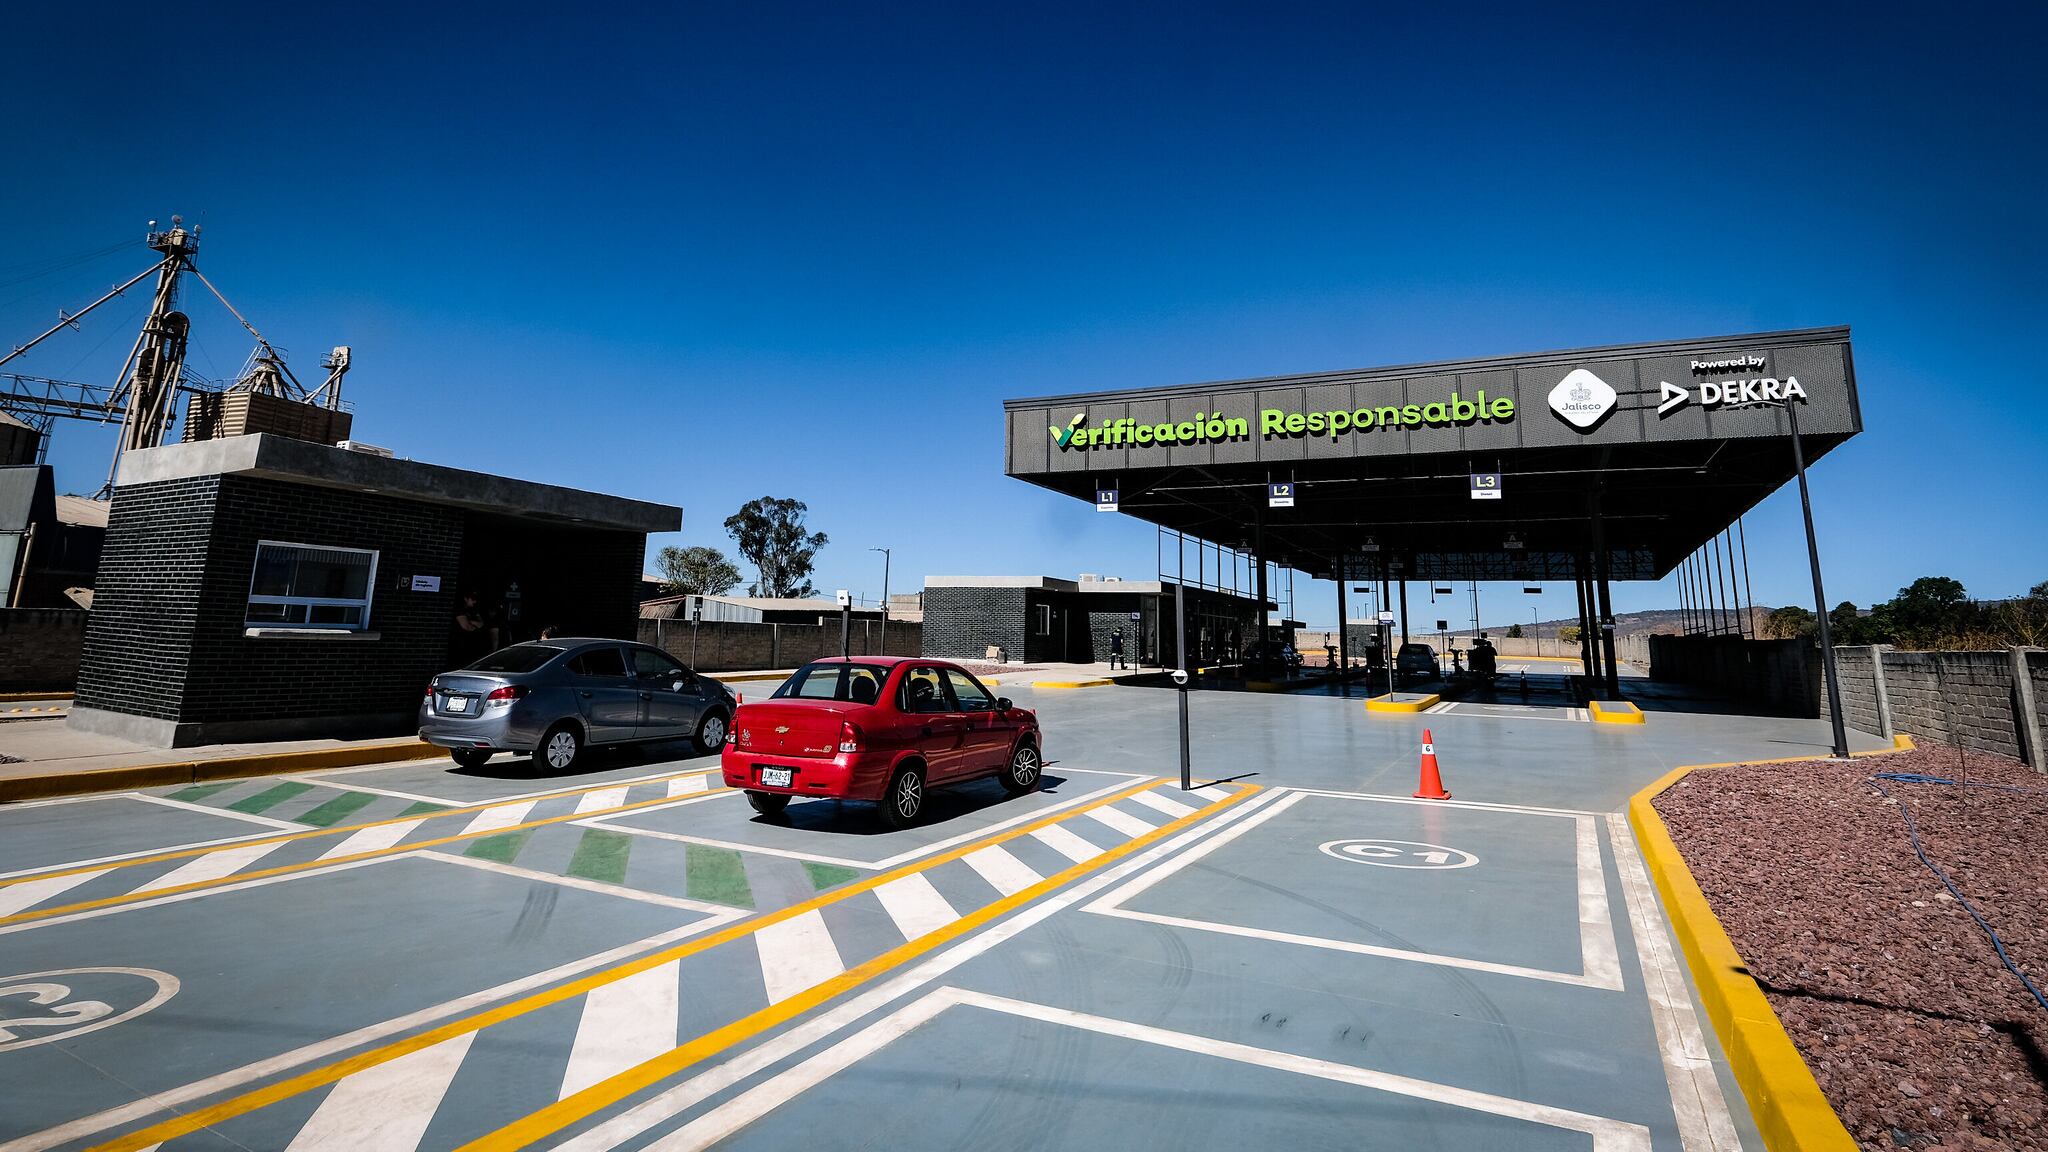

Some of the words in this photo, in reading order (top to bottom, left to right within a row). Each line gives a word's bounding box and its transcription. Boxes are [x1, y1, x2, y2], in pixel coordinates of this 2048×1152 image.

[1690, 358, 1746, 370] Powered
[1746, 356, 1766, 369] by
[1699, 375, 1808, 405] DEKRA
[1561, 402, 1602, 412] Jalisco
[1048, 412, 1248, 447] Verificación
[1260, 390, 1515, 442] Responsable
[1476, 475, 1496, 488] L3
[1101, 492, 1113, 502] L1
[1273, 485, 1289, 496] L2
[1342, 844, 1450, 864] C1
